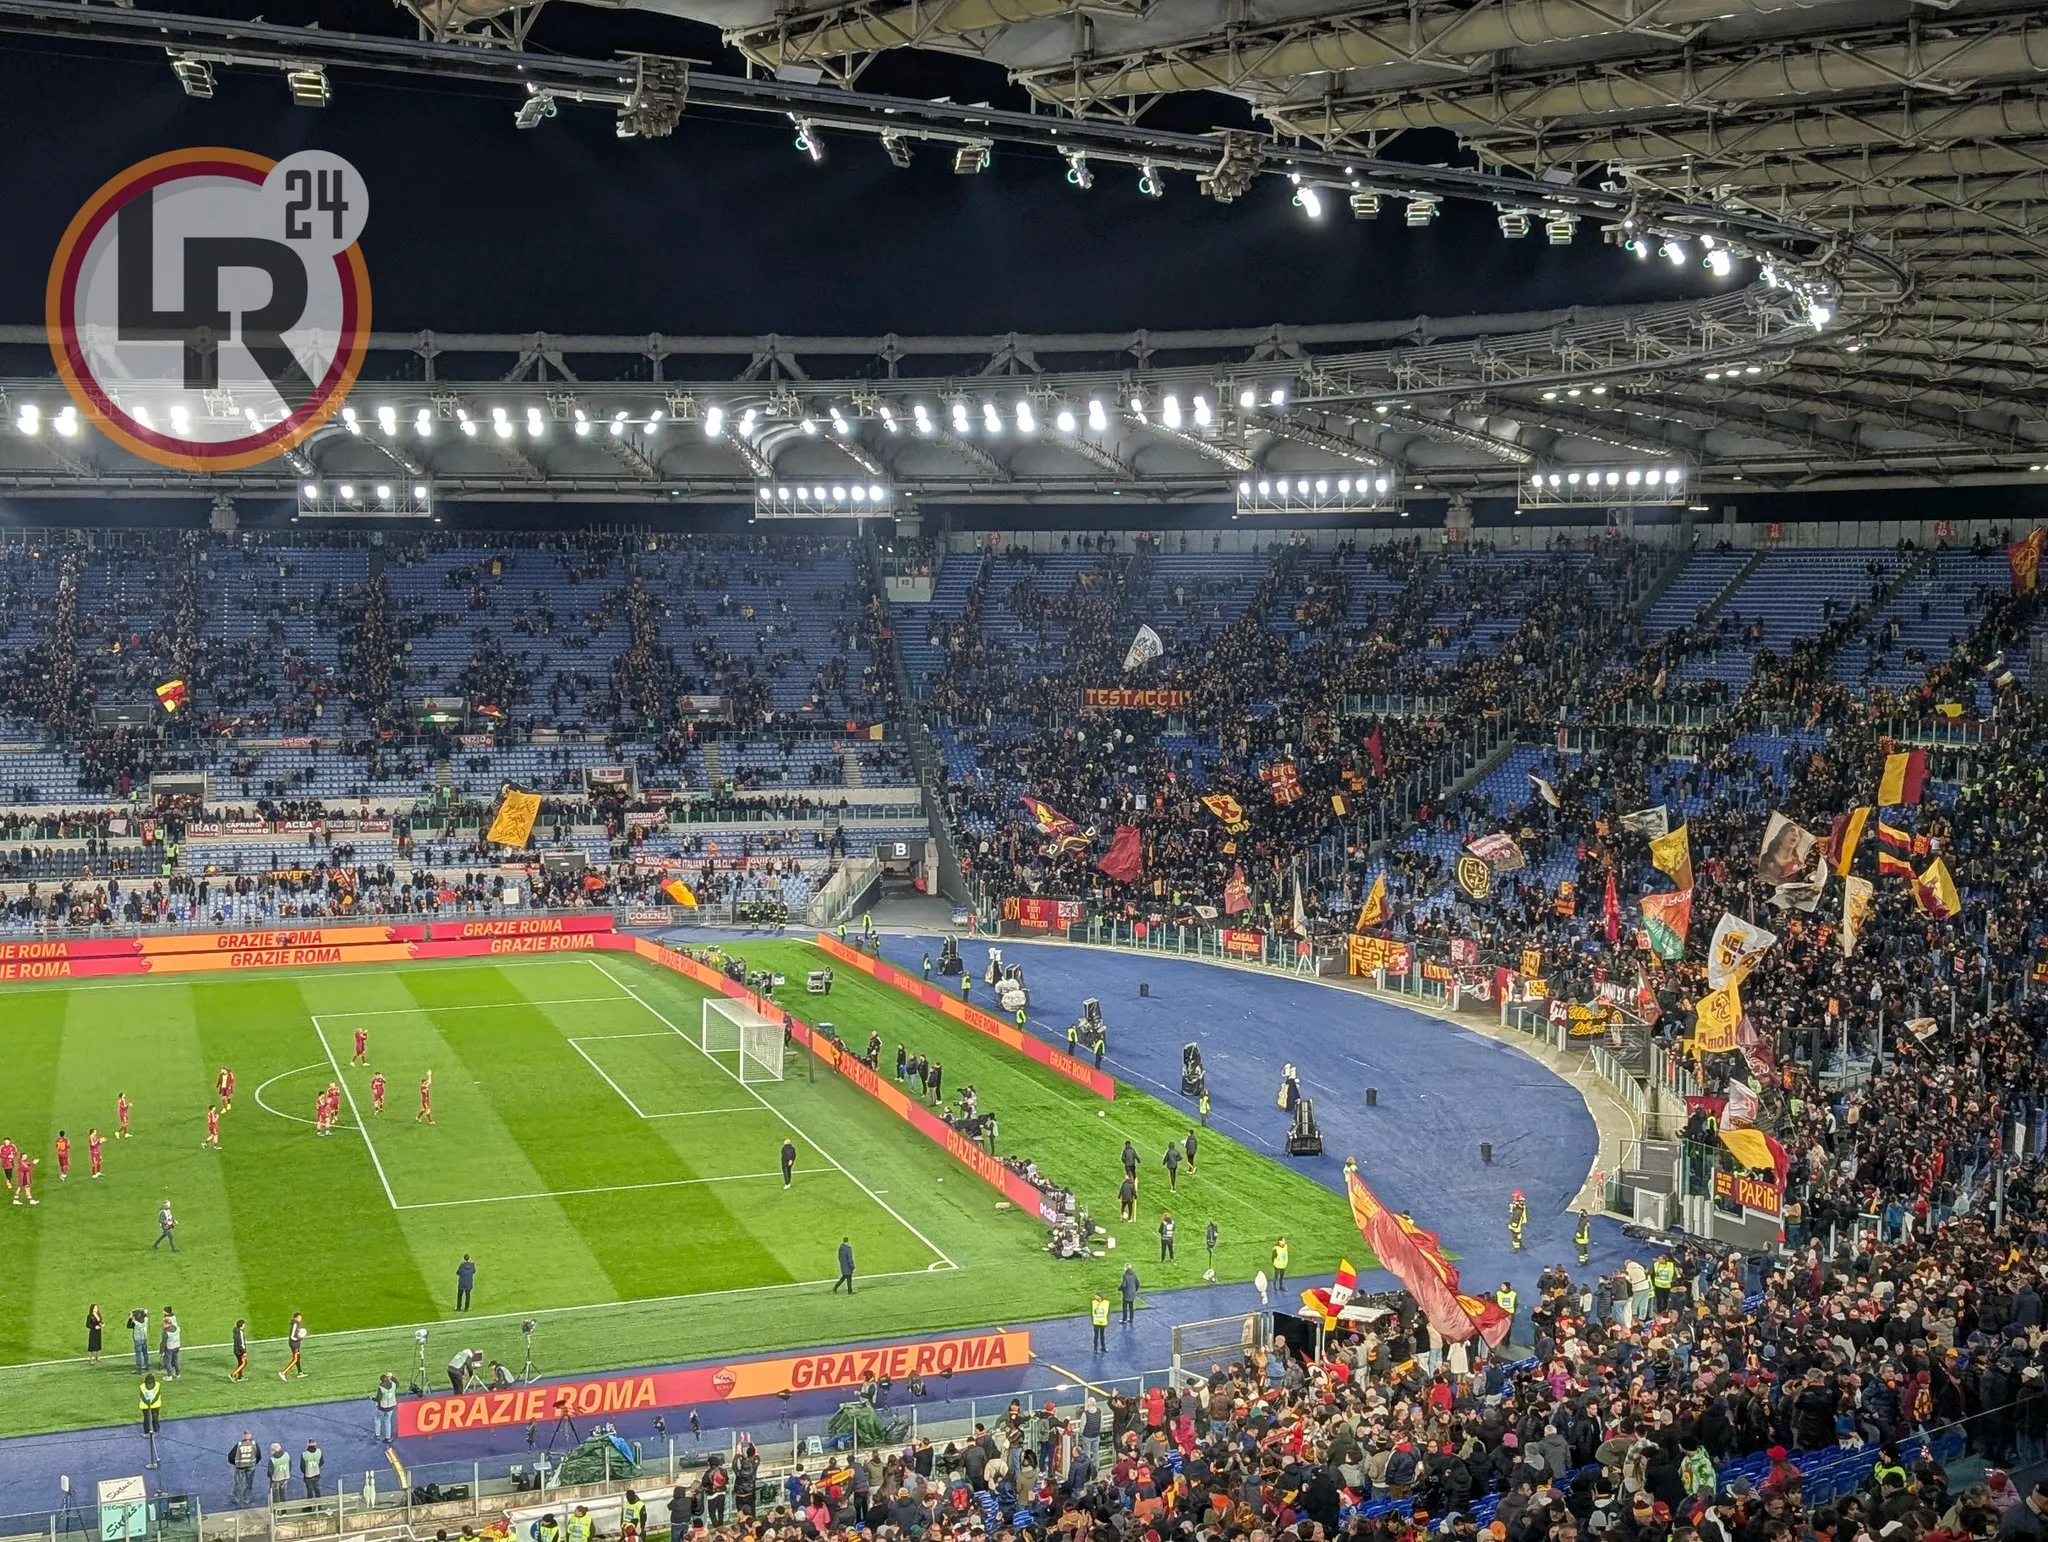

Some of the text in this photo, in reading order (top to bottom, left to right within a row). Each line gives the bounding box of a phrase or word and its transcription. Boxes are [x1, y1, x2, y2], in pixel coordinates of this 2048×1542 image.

[191, 823, 219, 833] IRAQ
[285, 820, 313, 829] ACEA
[896, 843, 907, 855] B
[629, 911, 673, 920] COSENZ
[463, 919, 563, 936] GRAZIE ROMA
[217, 934, 274, 949] GRAZIE
[491, 934, 595, 953] GRAZIE ROMA
[19, 943, 67, 958] ROMA
[231, 948, 342, 967] GRAZIE ROMA
[20, 961, 71, 977] ROMA
[964, 1009, 1000, 1036] GRAZIE ROMA
[1050, 1051, 1092, 1085] GRAZIE ROMA
[946, 1129, 1006, 1193] GRAZIE ROMA
[790, 1337, 1007, 1389] GRAZIE ROMA
[416, 1377, 658, 1433] GRAZIE ROMA
